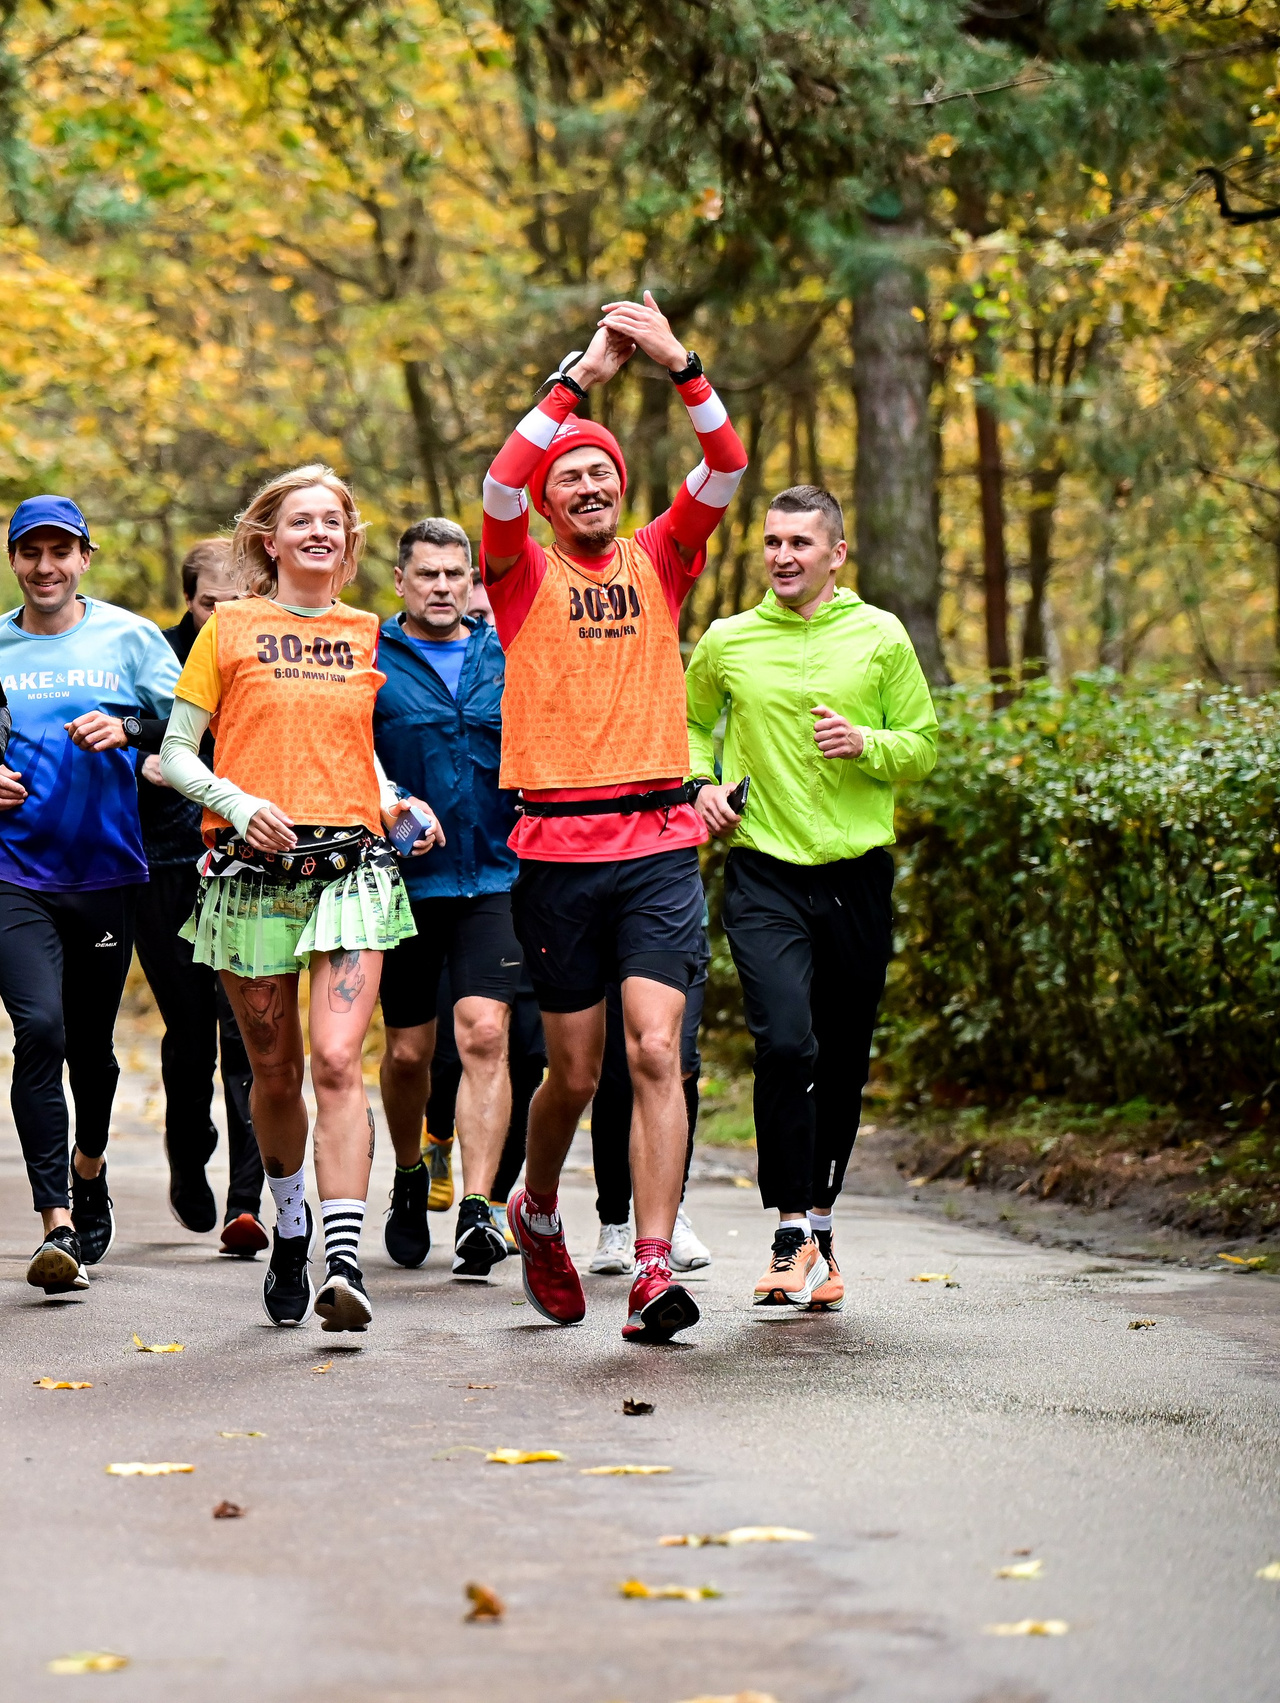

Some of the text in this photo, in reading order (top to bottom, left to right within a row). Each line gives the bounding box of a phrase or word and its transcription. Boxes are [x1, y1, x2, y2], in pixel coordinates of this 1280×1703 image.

[579, 627, 602, 639] 6:00
[256, 634, 354, 670] 30:00
[274, 667, 300, 679] 6:00
[27, 691, 70, 700] MOSCOW
